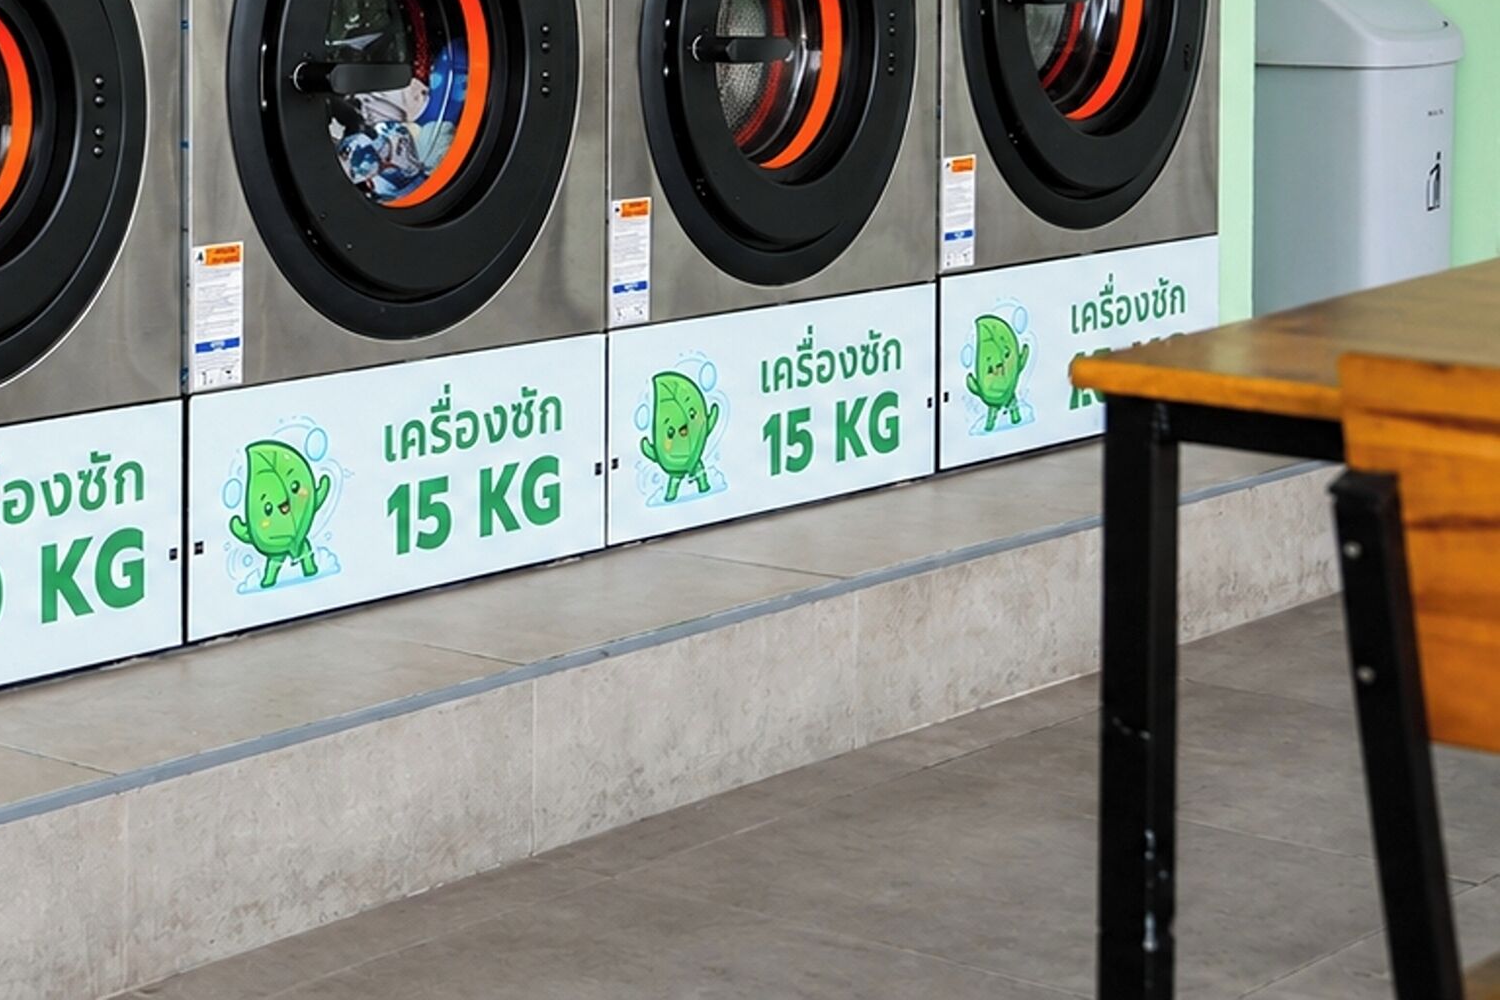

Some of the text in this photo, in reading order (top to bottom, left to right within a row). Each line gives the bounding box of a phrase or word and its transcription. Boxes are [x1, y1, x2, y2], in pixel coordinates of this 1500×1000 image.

[1071, 273, 1186, 335] เครื่องซัก
[760, 325, 902, 394] เครื่องซัก
[384, 383, 563, 463] เครื่องซัก
[762, 390, 901, 477] 15 KG
[386, 454, 562, 556] 15 KG
[41, 527, 146, 624] KG
